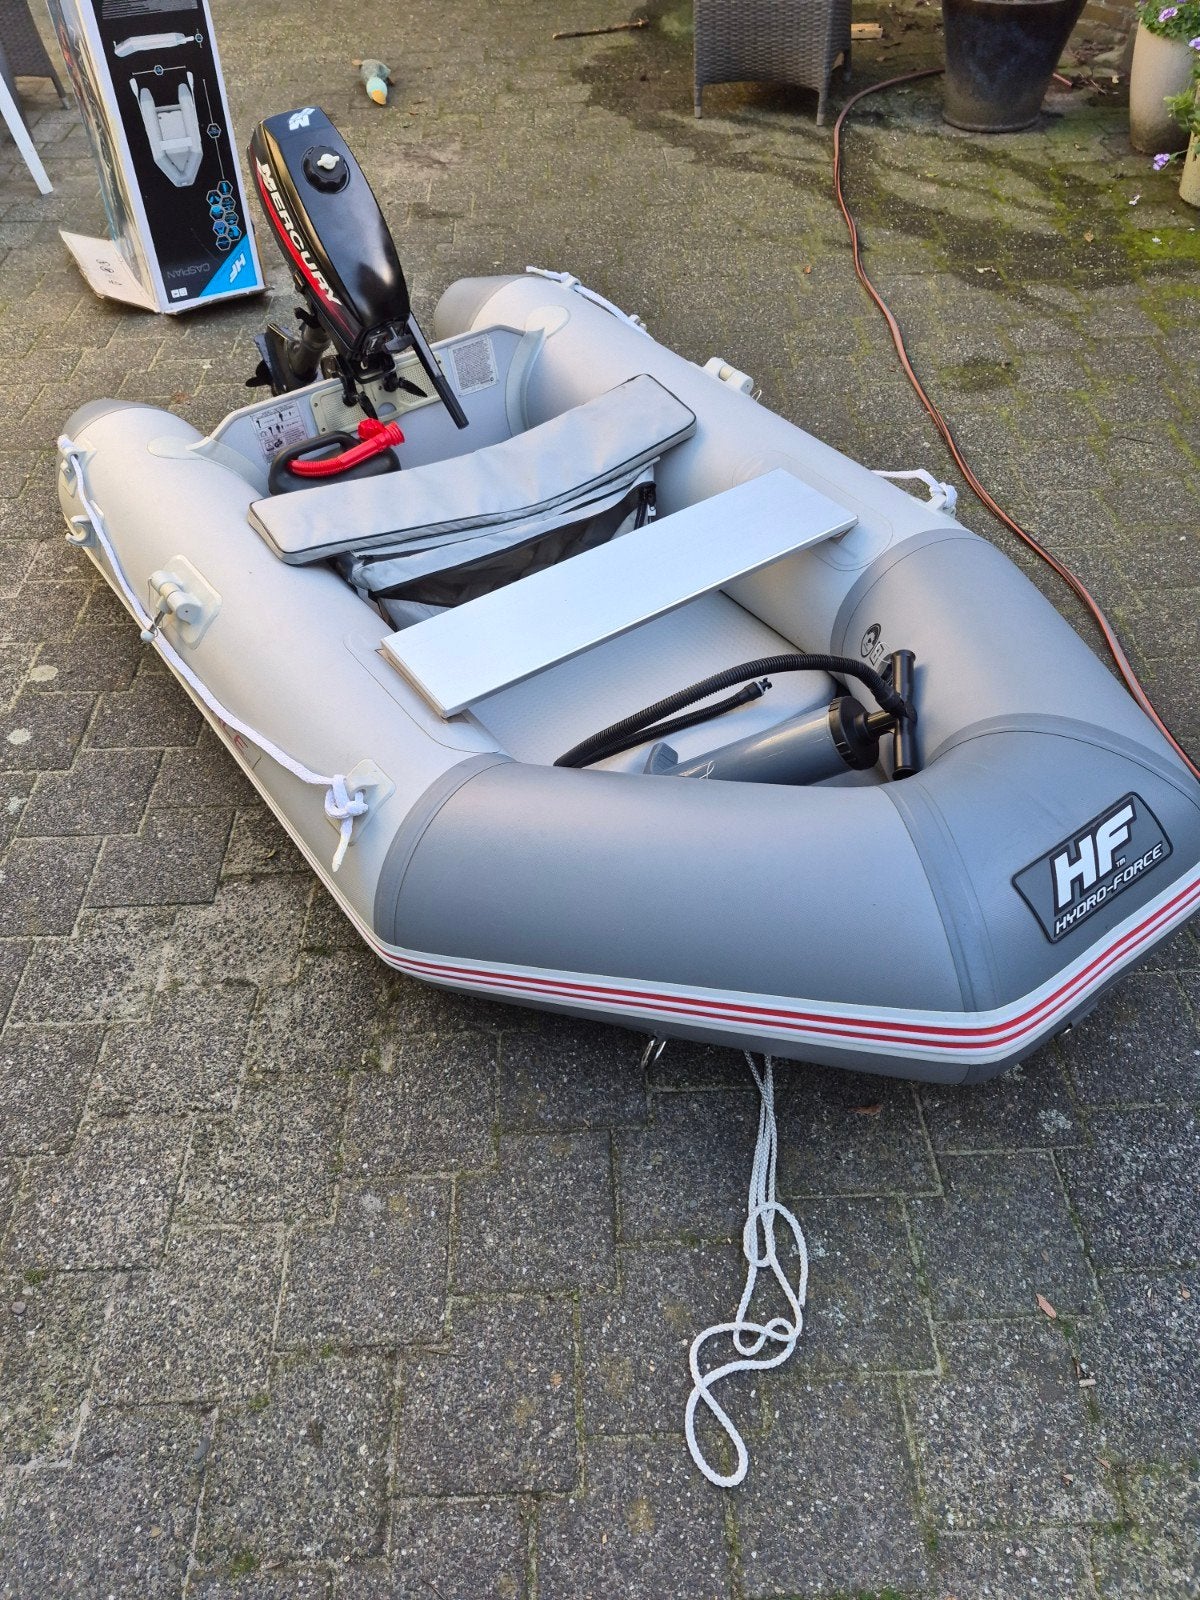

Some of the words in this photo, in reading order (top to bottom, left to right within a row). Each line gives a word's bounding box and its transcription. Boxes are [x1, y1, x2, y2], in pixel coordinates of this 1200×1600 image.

[167, 262, 211, 279] CASPIAN
[229, 253, 246, 283] HF
[255, 157, 342, 306] MERCURY
[1054, 804, 1134, 908] HF
[1055, 843, 1163, 934] HYDRO-FORCE
